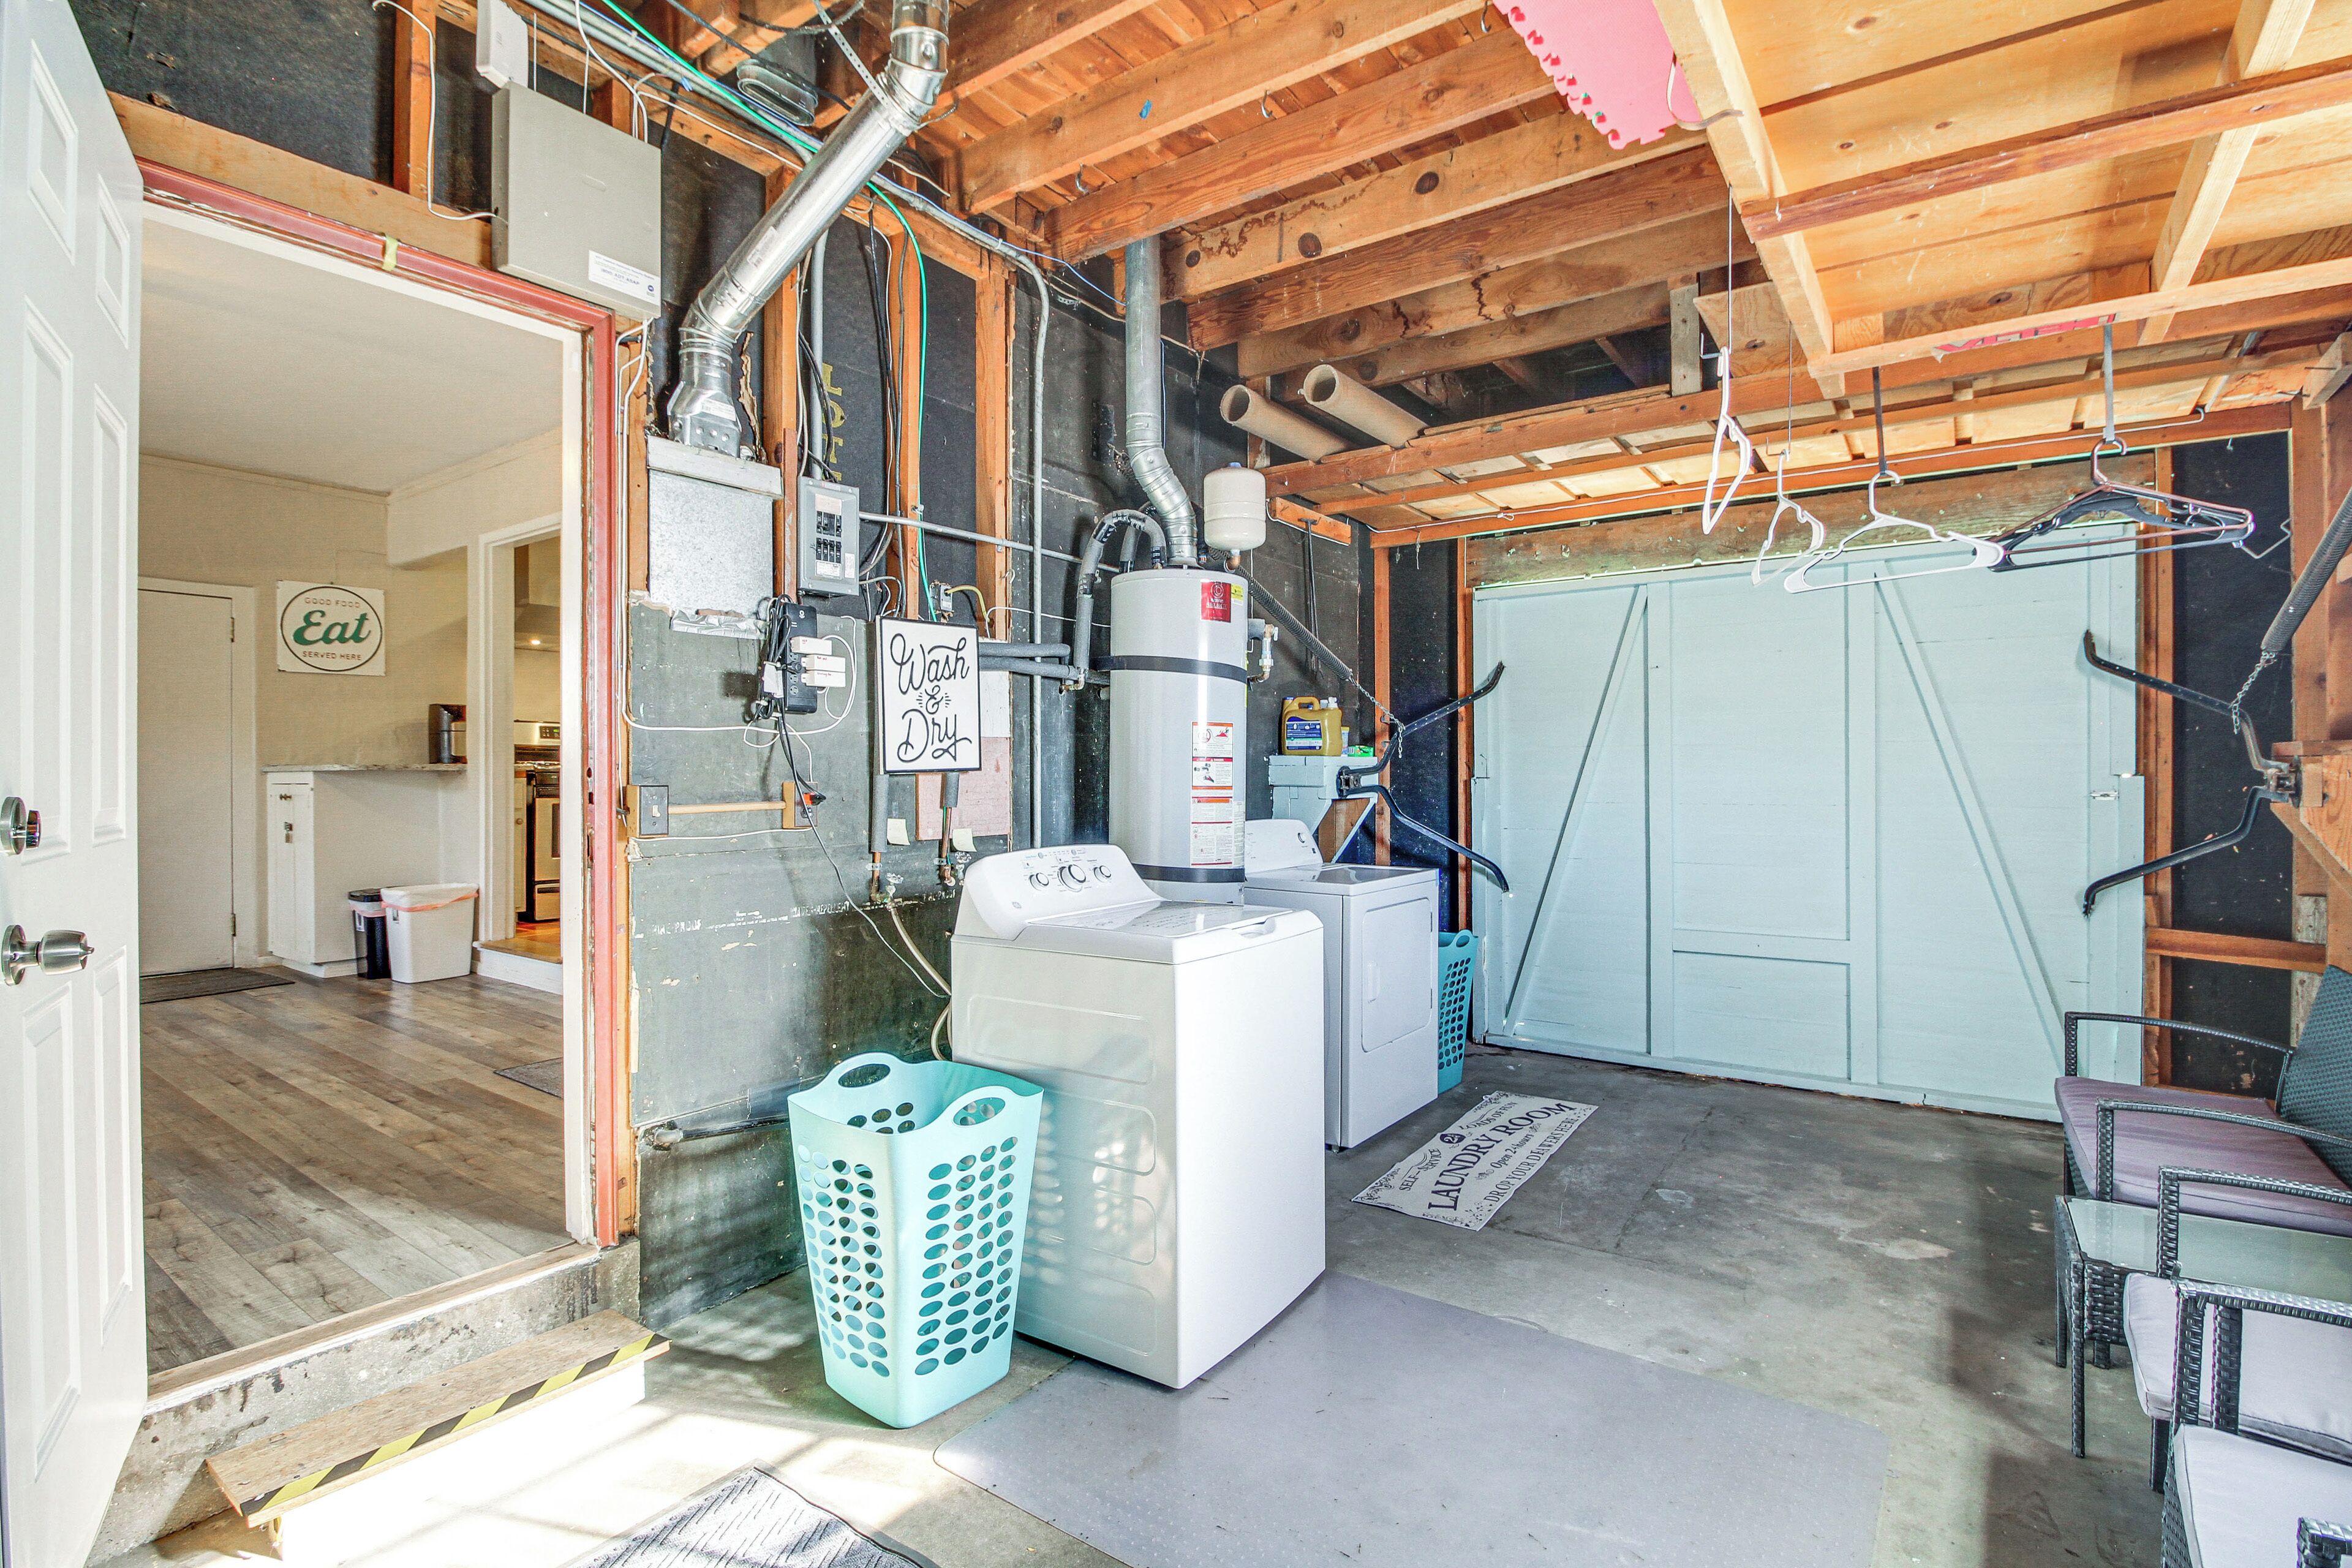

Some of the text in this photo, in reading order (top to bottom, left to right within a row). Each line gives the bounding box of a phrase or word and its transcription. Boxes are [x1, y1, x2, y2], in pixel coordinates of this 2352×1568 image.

[304, 597, 361, 608] GOOD FOOD
[293, 610, 371, 646] Eat
[303, 651, 361, 661] SERVED HERE
[890, 633, 970, 695] Wash
[925, 685, 943, 714] &
[897, 709, 972, 763] Dry
[1459, 1116, 1496, 1130] LOADS
[1427, 1102, 1577, 1211] LAUNDRY ROOM
[1483, 1180, 1515, 1202] DROP
[1506, 1161, 1536, 1180] YOUR
[1555, 1117, 1578, 1133] HERE
[1490, 1154, 1512, 1169] Open
